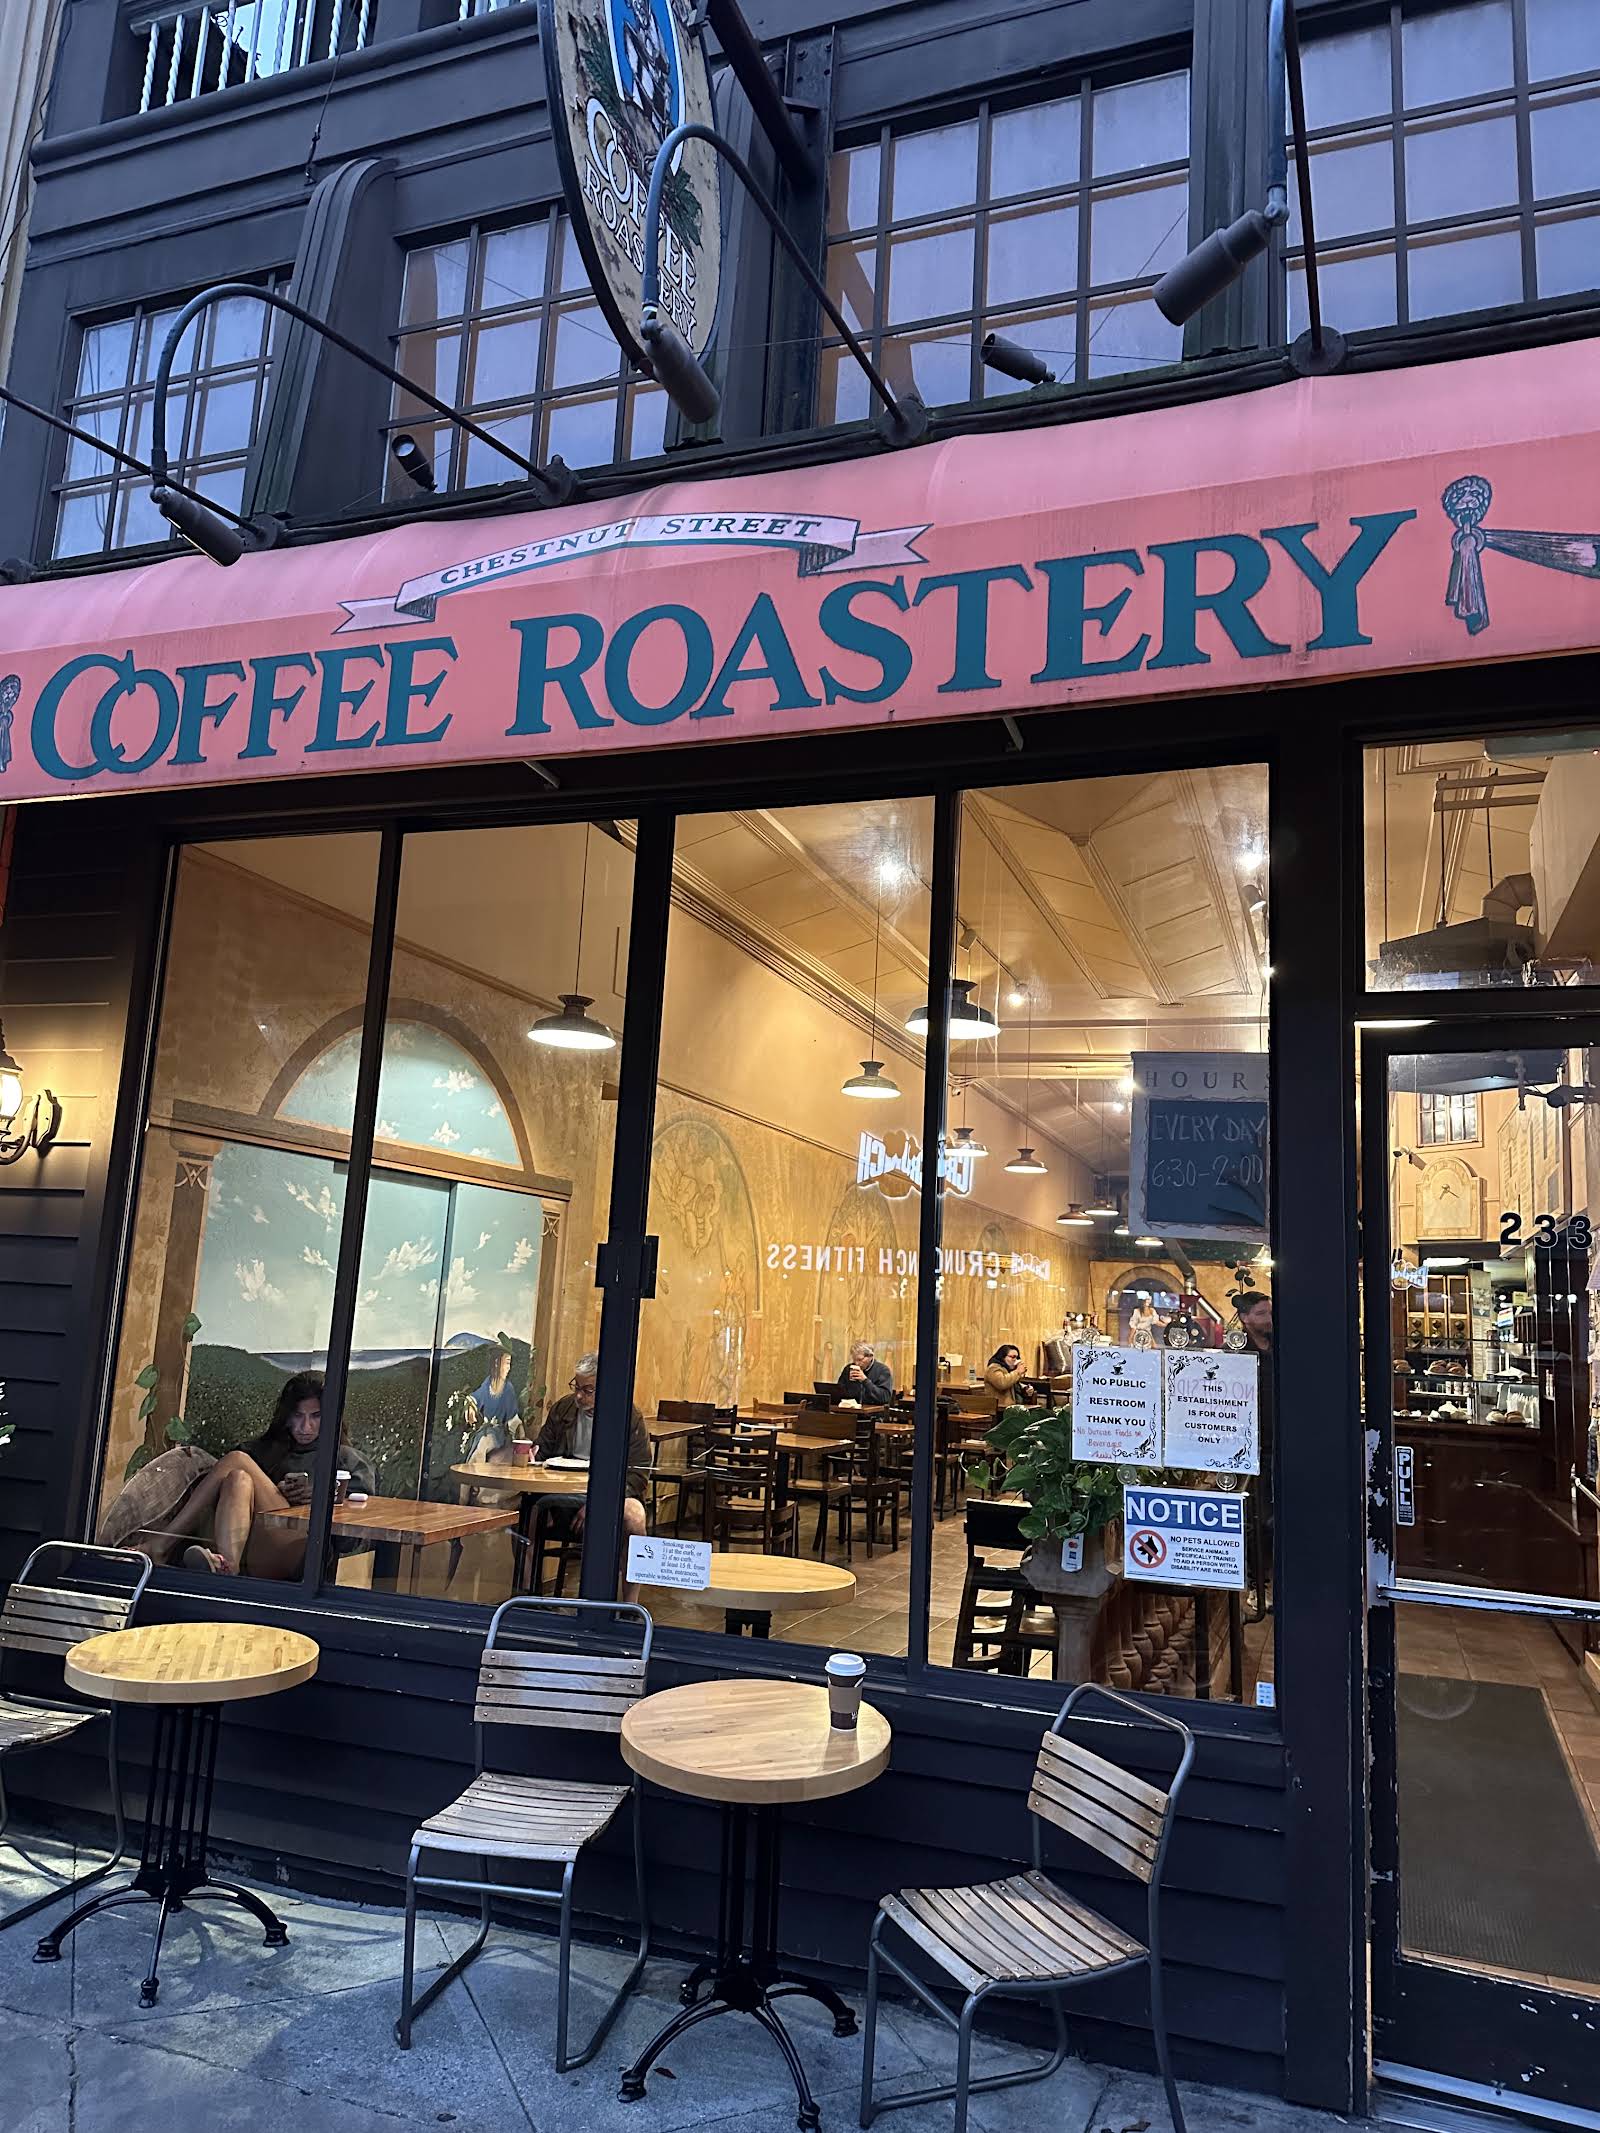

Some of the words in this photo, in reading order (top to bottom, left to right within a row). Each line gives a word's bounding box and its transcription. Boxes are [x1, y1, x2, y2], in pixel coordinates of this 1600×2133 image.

[586, 98, 696, 308] COFEE
[583, 158, 697, 348] ROASERY
[440, 521, 635, 584] CHESTNUT
[660, 518, 822, 537] STREET
[30, 636, 459, 780] COFFEE
[505, 509, 1416, 736] ROASTERY
[1152, 1114, 1218, 1141] EVERY
[1223, 1114, 1266, 1147] DAY
[1110, 1379, 1146, 1388] PUBLIC
[1090, 1397, 1145, 1408] RESTROOM
[1178, 1396, 1248, 1407] ESTABLISHMENT
[1087, 1415, 1121, 1424] THANK
[1124, 1418, 1146, 1426] YOU
[1185, 1422, 1237, 1432] CUSTOMERS
[1398, 1452, 1410, 1506] PULL
[1127, 1496, 1240, 1528] NOTICE
[1203, 1538, 1240, 1547] ALLOWED
[1175, 1552, 1211, 1560] SPECIFICALLY
